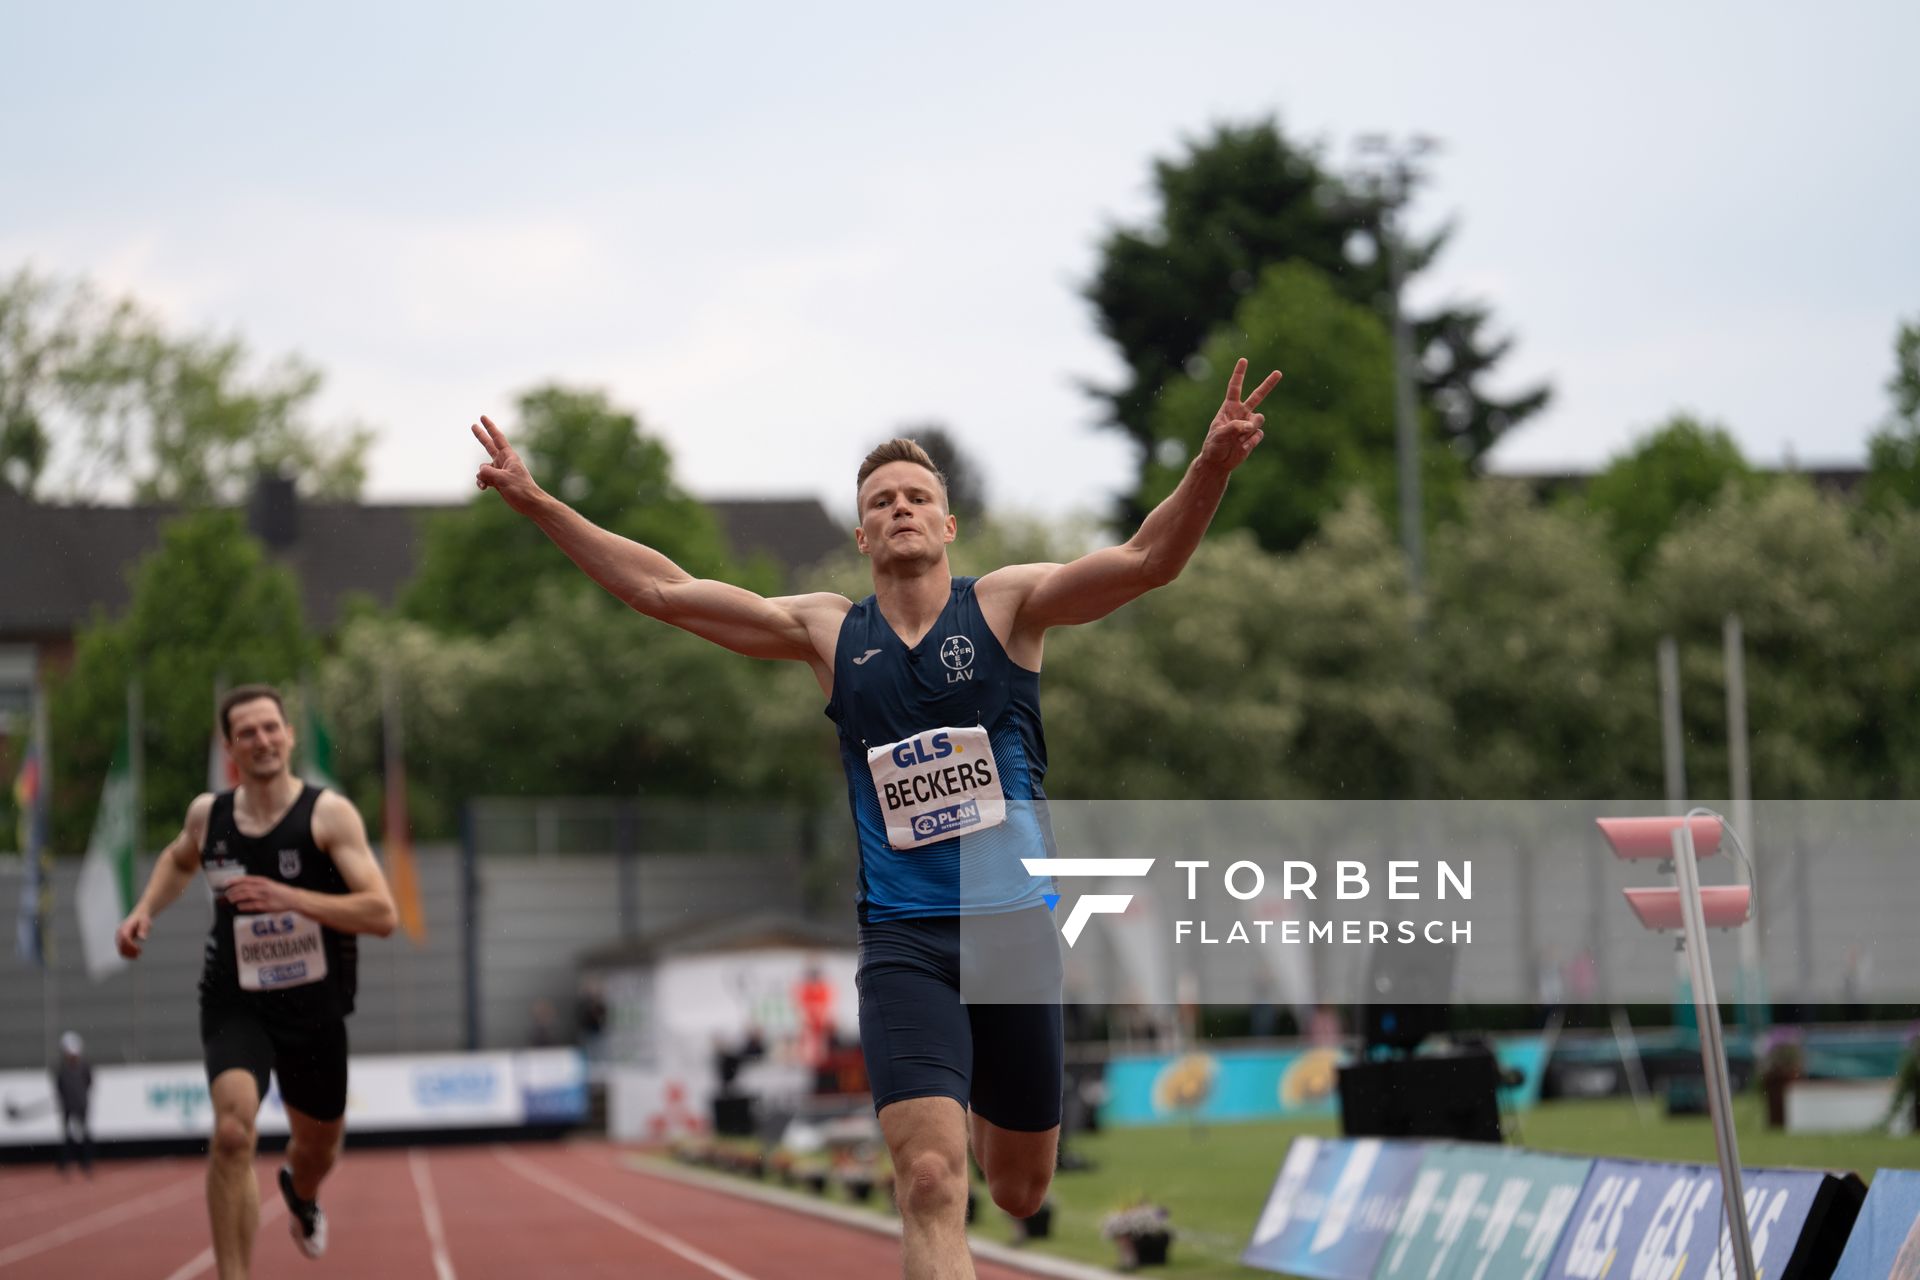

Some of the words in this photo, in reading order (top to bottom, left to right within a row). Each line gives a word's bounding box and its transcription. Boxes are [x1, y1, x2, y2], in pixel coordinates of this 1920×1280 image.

[946, 668, 974, 683] LAV
[884, 758, 992, 811] BECKERS
[938, 805, 976, 824] PLAN
[241, 933, 318, 964] DIECKMANN
